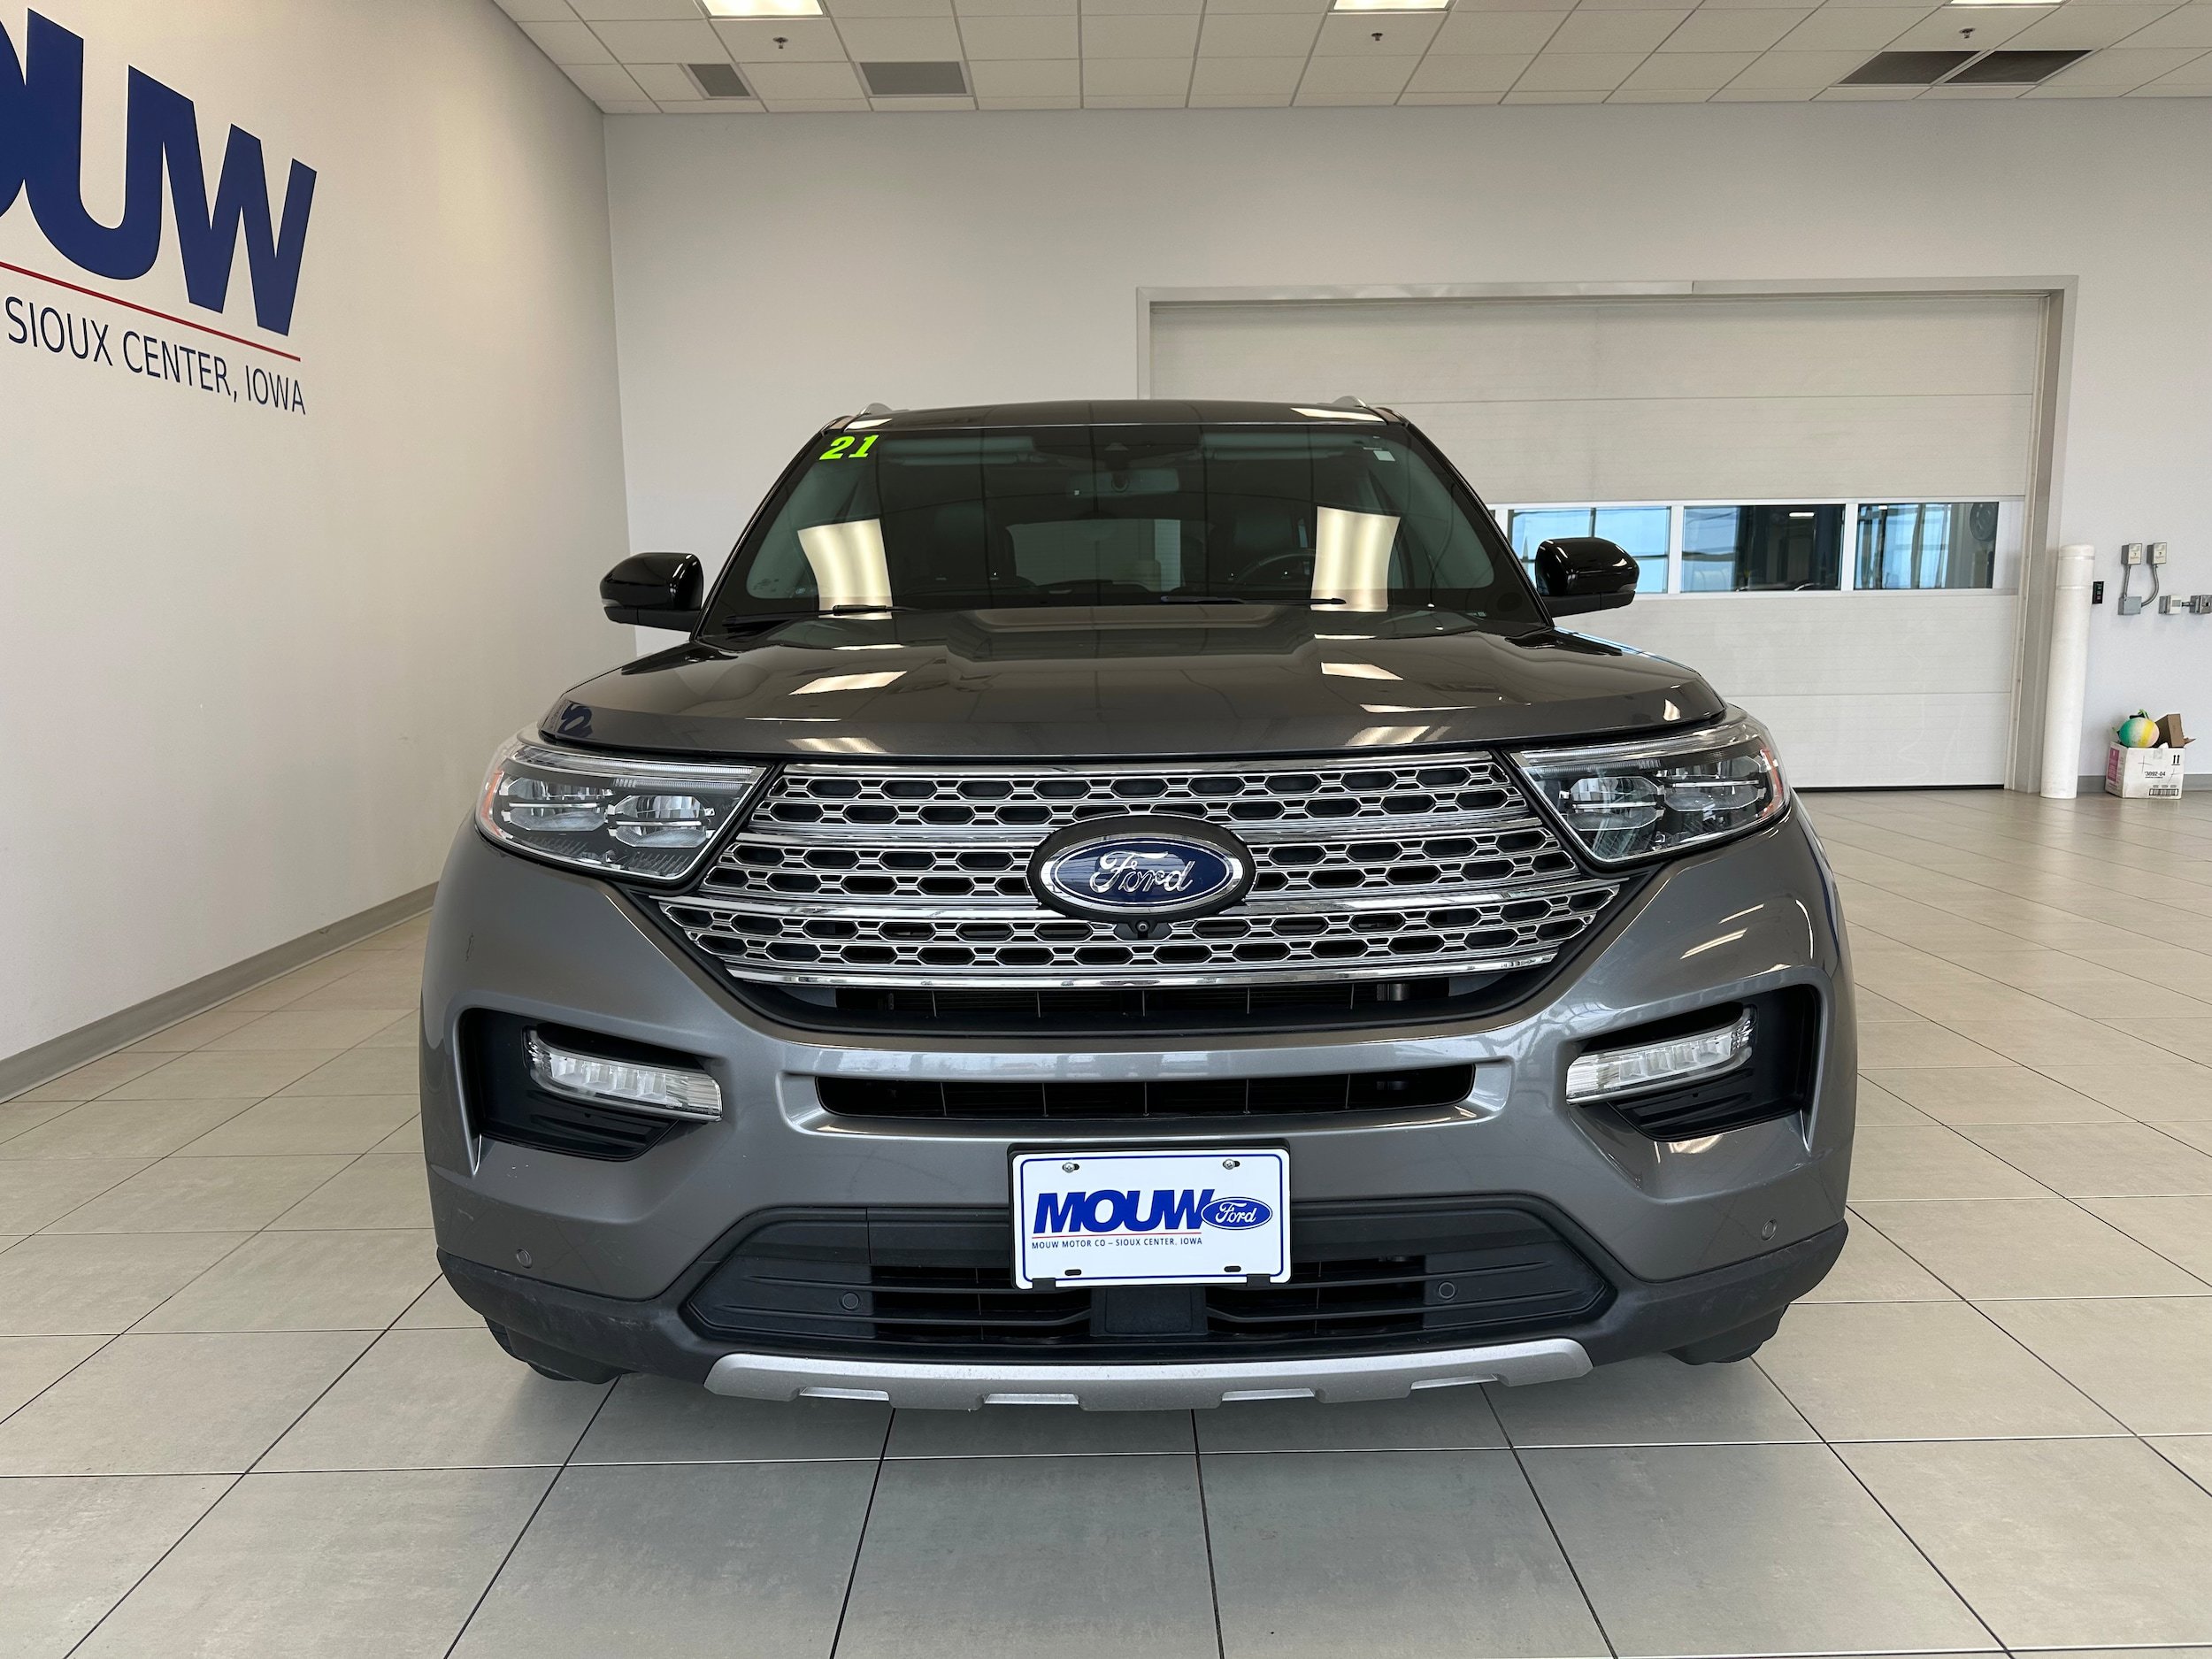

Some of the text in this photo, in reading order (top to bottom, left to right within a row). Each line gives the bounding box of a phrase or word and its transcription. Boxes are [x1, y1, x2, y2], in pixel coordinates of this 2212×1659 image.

[4, 296, 306, 415] SIOUX CENTER, IOWA
[818, 434, 879, 460] 21
[1089, 849, 1195, 893] Ford
[1033, 1189, 1215, 1233] MOUW
[1215, 1202, 1256, 1224] Ford
[1032, 1240, 1059, 1249] MOUW
